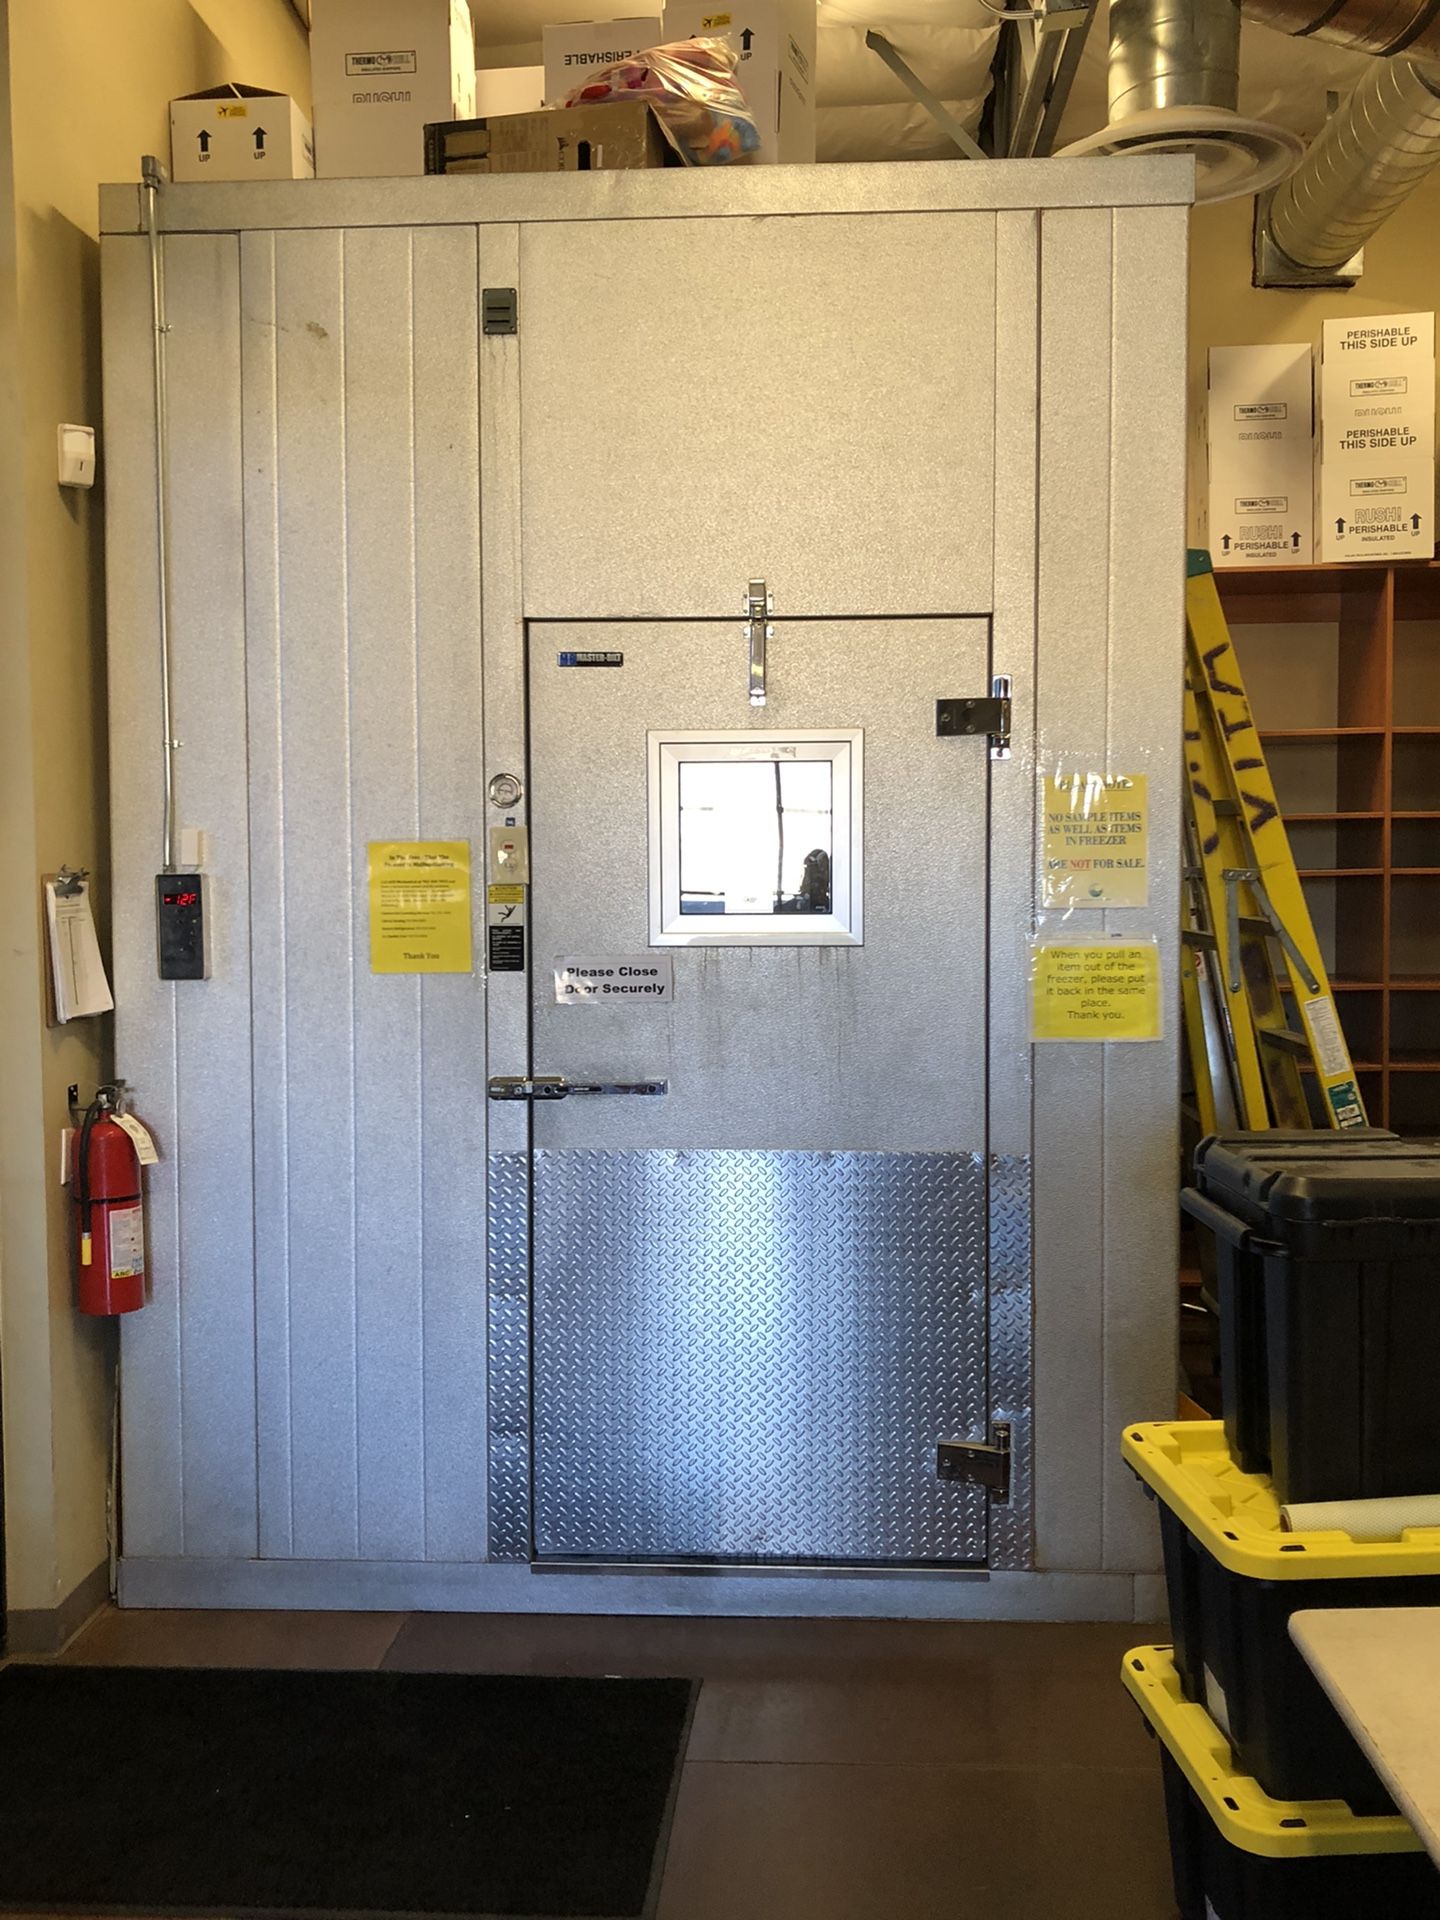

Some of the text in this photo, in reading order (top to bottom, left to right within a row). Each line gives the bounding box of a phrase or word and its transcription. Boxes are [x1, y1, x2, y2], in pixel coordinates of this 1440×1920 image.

[564, 50, 640, 65] ERISHABLE
[740, 52, 752, 60] UP
[198, 154, 211, 162] UP
[254, 151, 266, 159] UP
[1347, 326, 1411, 339] PERISHABLE
[1340, 336, 1418, 350] THIS SIDE UP
[1346, 427, 1410, 439] PERISHABLE
[1339, 436, 1417, 449] THIS SIDE UP
[1355, 506, 1402, 524] RUSH!
[1239, 525, 1283, 540] RUSH!
[1349, 523, 1408, 534] PERISHABLE
[1234, 541, 1289, 550] PERISHABLE
[1049, 811, 1142, 822] NO SAMPLE ITEMS
[1049, 823, 1142, 834] AS WELL AS ITEMS
[1066, 835, 1126, 846] IN FREEZER
[1070, 859, 1091, 869] NOT
[1093, 859, 1114, 869] FOR
[1116, 858, 1145, 868] SALE.
[403, 952, 440, 960] Thank You
[1050, 950, 1141, 960] When you pull an
[567, 967, 658, 977] Please Close
[1057, 962, 1135, 971] item out of the
[1091, 975, 1124, 984] please
[1127, 974, 1145, 983] put
[602, 983, 665, 995] Securely
[1046, 987, 1055, 995] it
[1057, 986, 1081, 995] back
[1084, 987, 1095, 995] in
[1097, 986, 1114, 995] the
[1081, 999, 1111, 1008] place.
[1067, 1010, 1125, 1020] Thank you.
